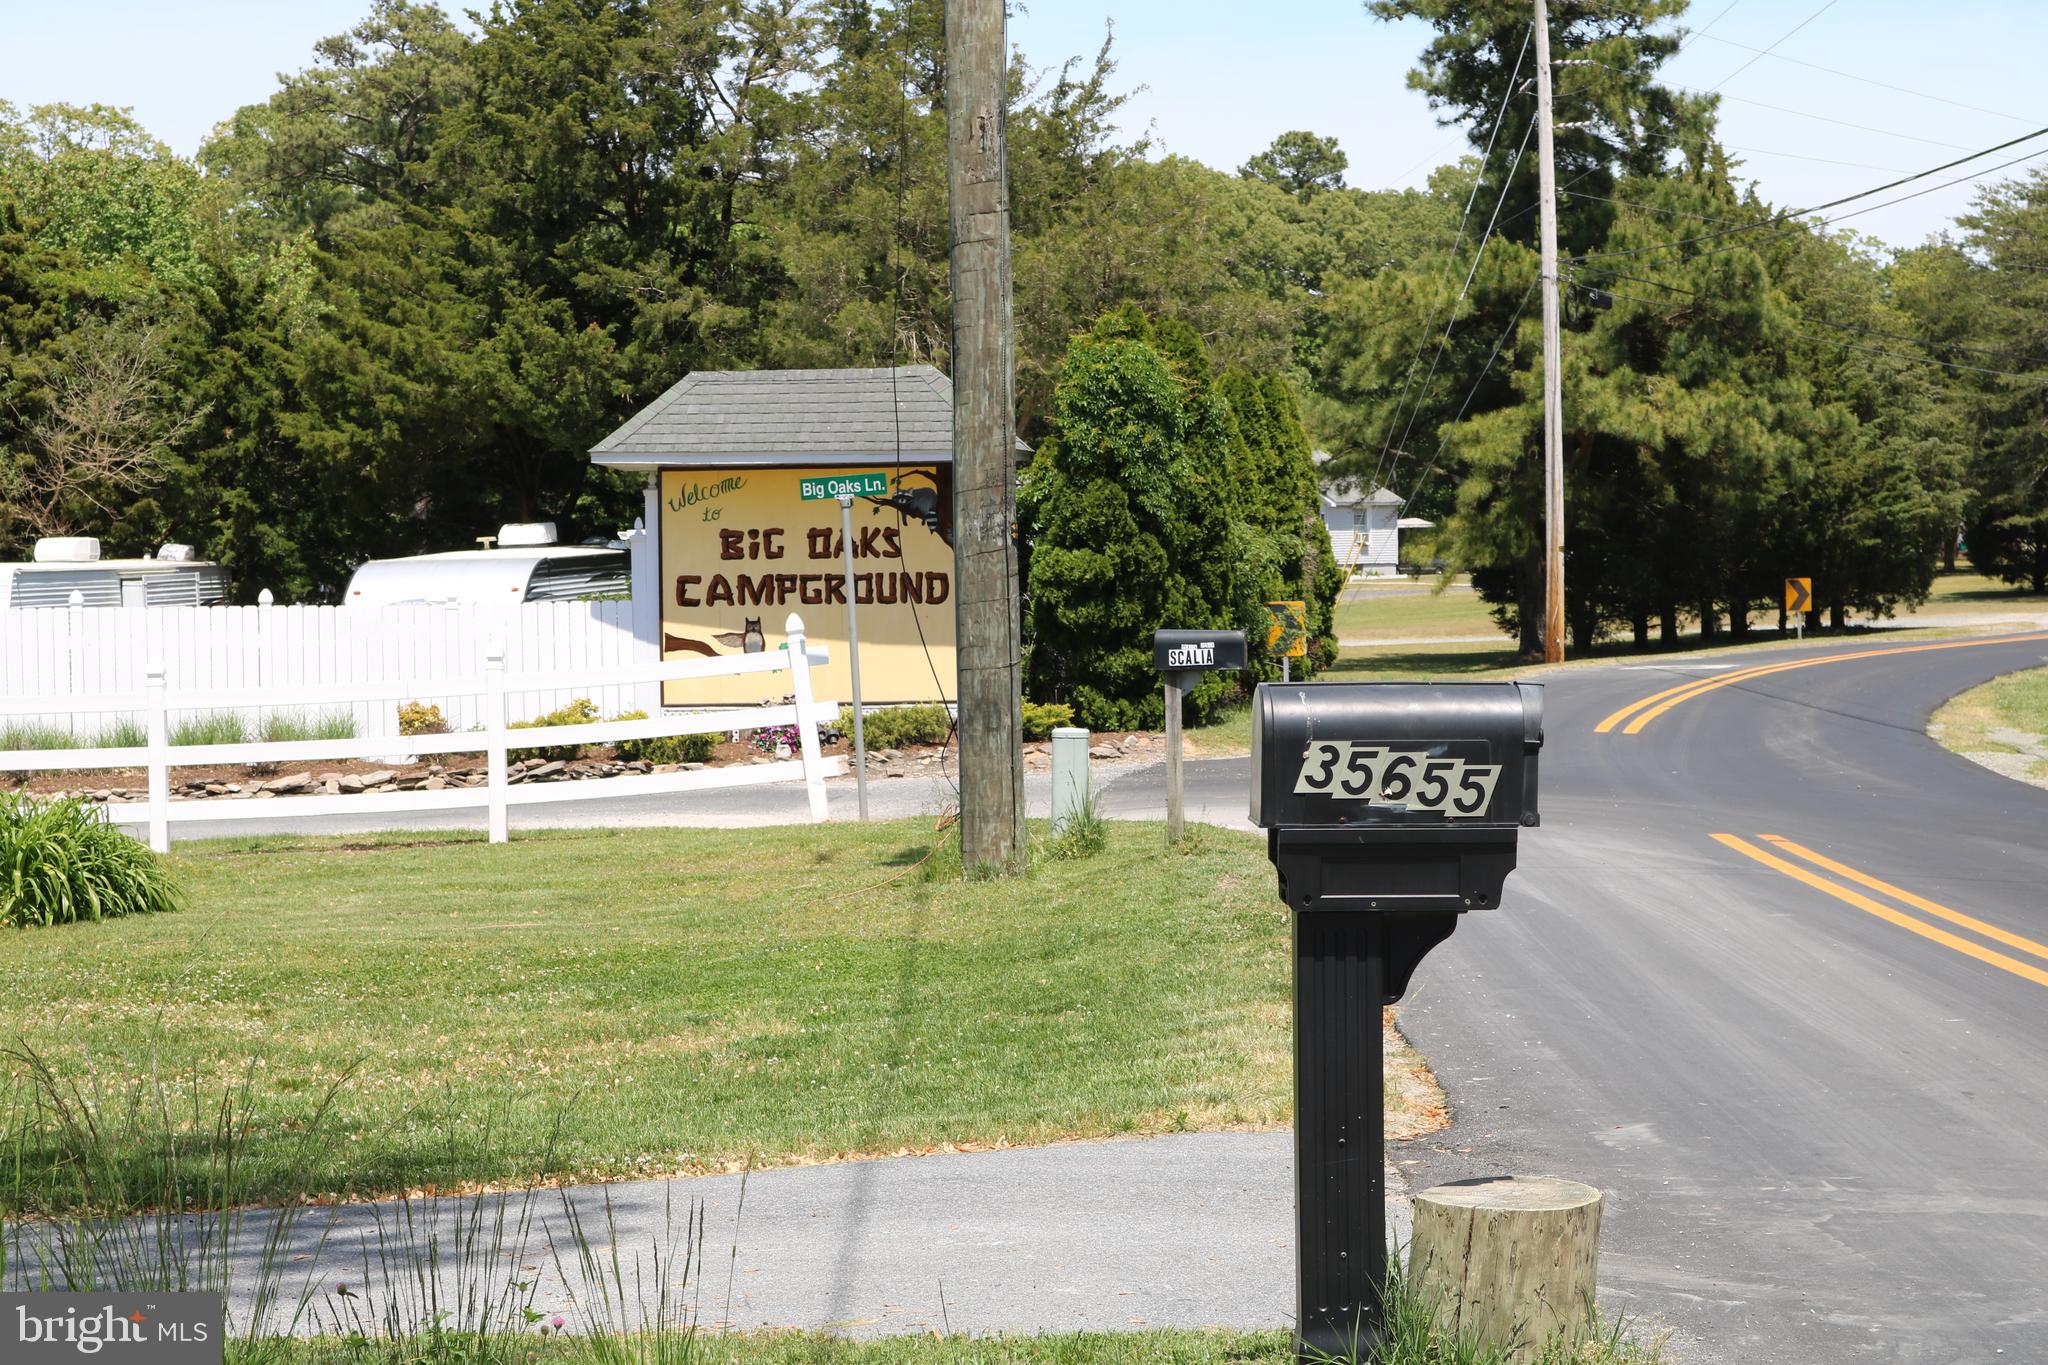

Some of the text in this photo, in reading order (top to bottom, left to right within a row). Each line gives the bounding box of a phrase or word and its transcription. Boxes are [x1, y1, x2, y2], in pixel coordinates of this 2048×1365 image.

[668, 476, 747, 512] Welcome
[802, 478, 885, 498] Big Oaks Ln.
[702, 506, 723, 522] to
[807, 526, 902, 559] OAKS
[675, 571, 950, 606] CAMPGROUND
[1170, 650, 1212, 665] SCALIA
[1304, 744, 1492, 814] 35655
